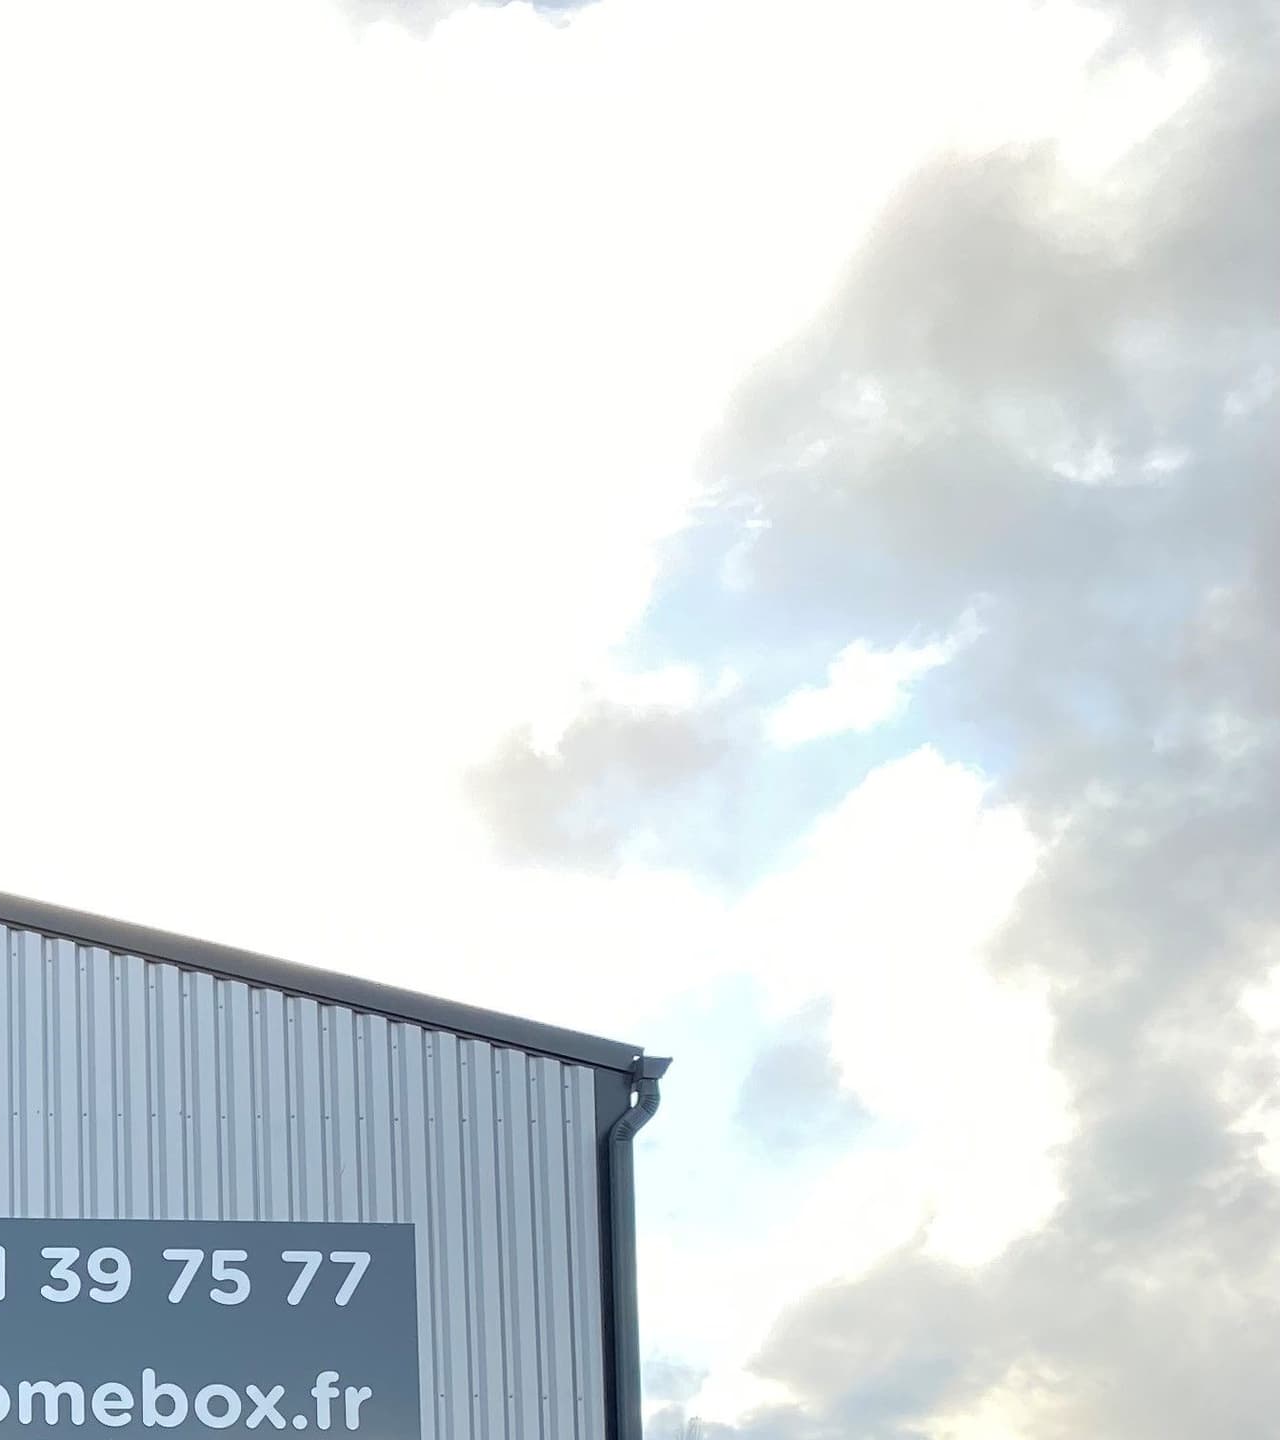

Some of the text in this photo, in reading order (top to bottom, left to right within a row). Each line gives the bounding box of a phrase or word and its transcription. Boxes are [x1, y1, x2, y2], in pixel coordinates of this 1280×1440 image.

[39, 1246, 132, 1304] 39
[161, 1248, 252, 1306] 75
[280, 1250, 372, 1307] 77
